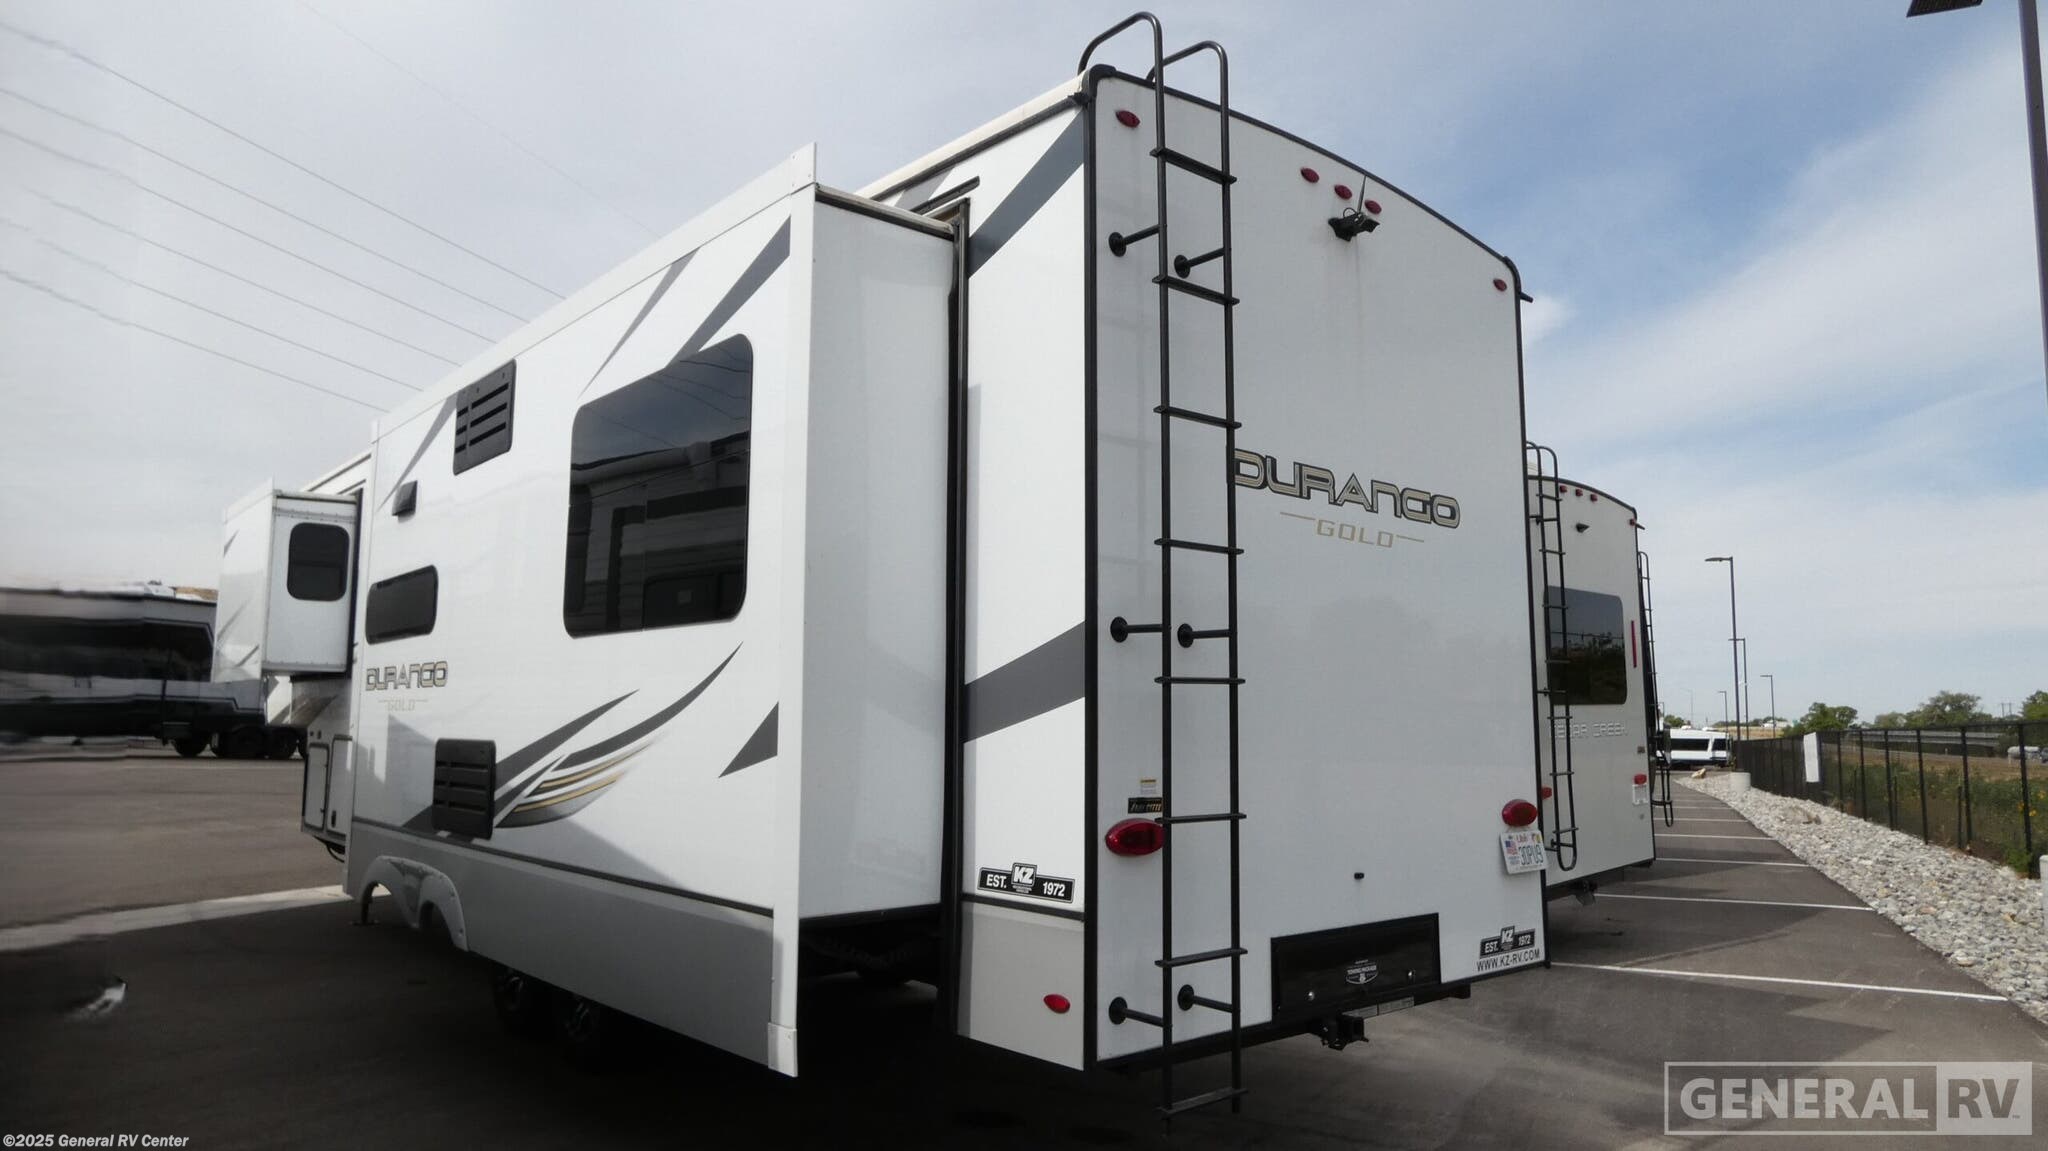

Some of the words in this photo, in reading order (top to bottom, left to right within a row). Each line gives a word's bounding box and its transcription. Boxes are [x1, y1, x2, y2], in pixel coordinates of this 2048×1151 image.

[1234, 448, 1461, 529] DURANGO
[1316, 519, 1394, 548] GOLD
[365, 661, 448, 691] DURANGO
[986, 873, 1007, 889] EST.
[1013, 866, 1034, 885] KZ
[1043, 881, 1066, 897] 1972
[1484, 941, 1499, 954] EST.
[1501, 929, 1514, 944] KZ
[1476, 949, 1541, 972] WWW.KZ-RV.COM
